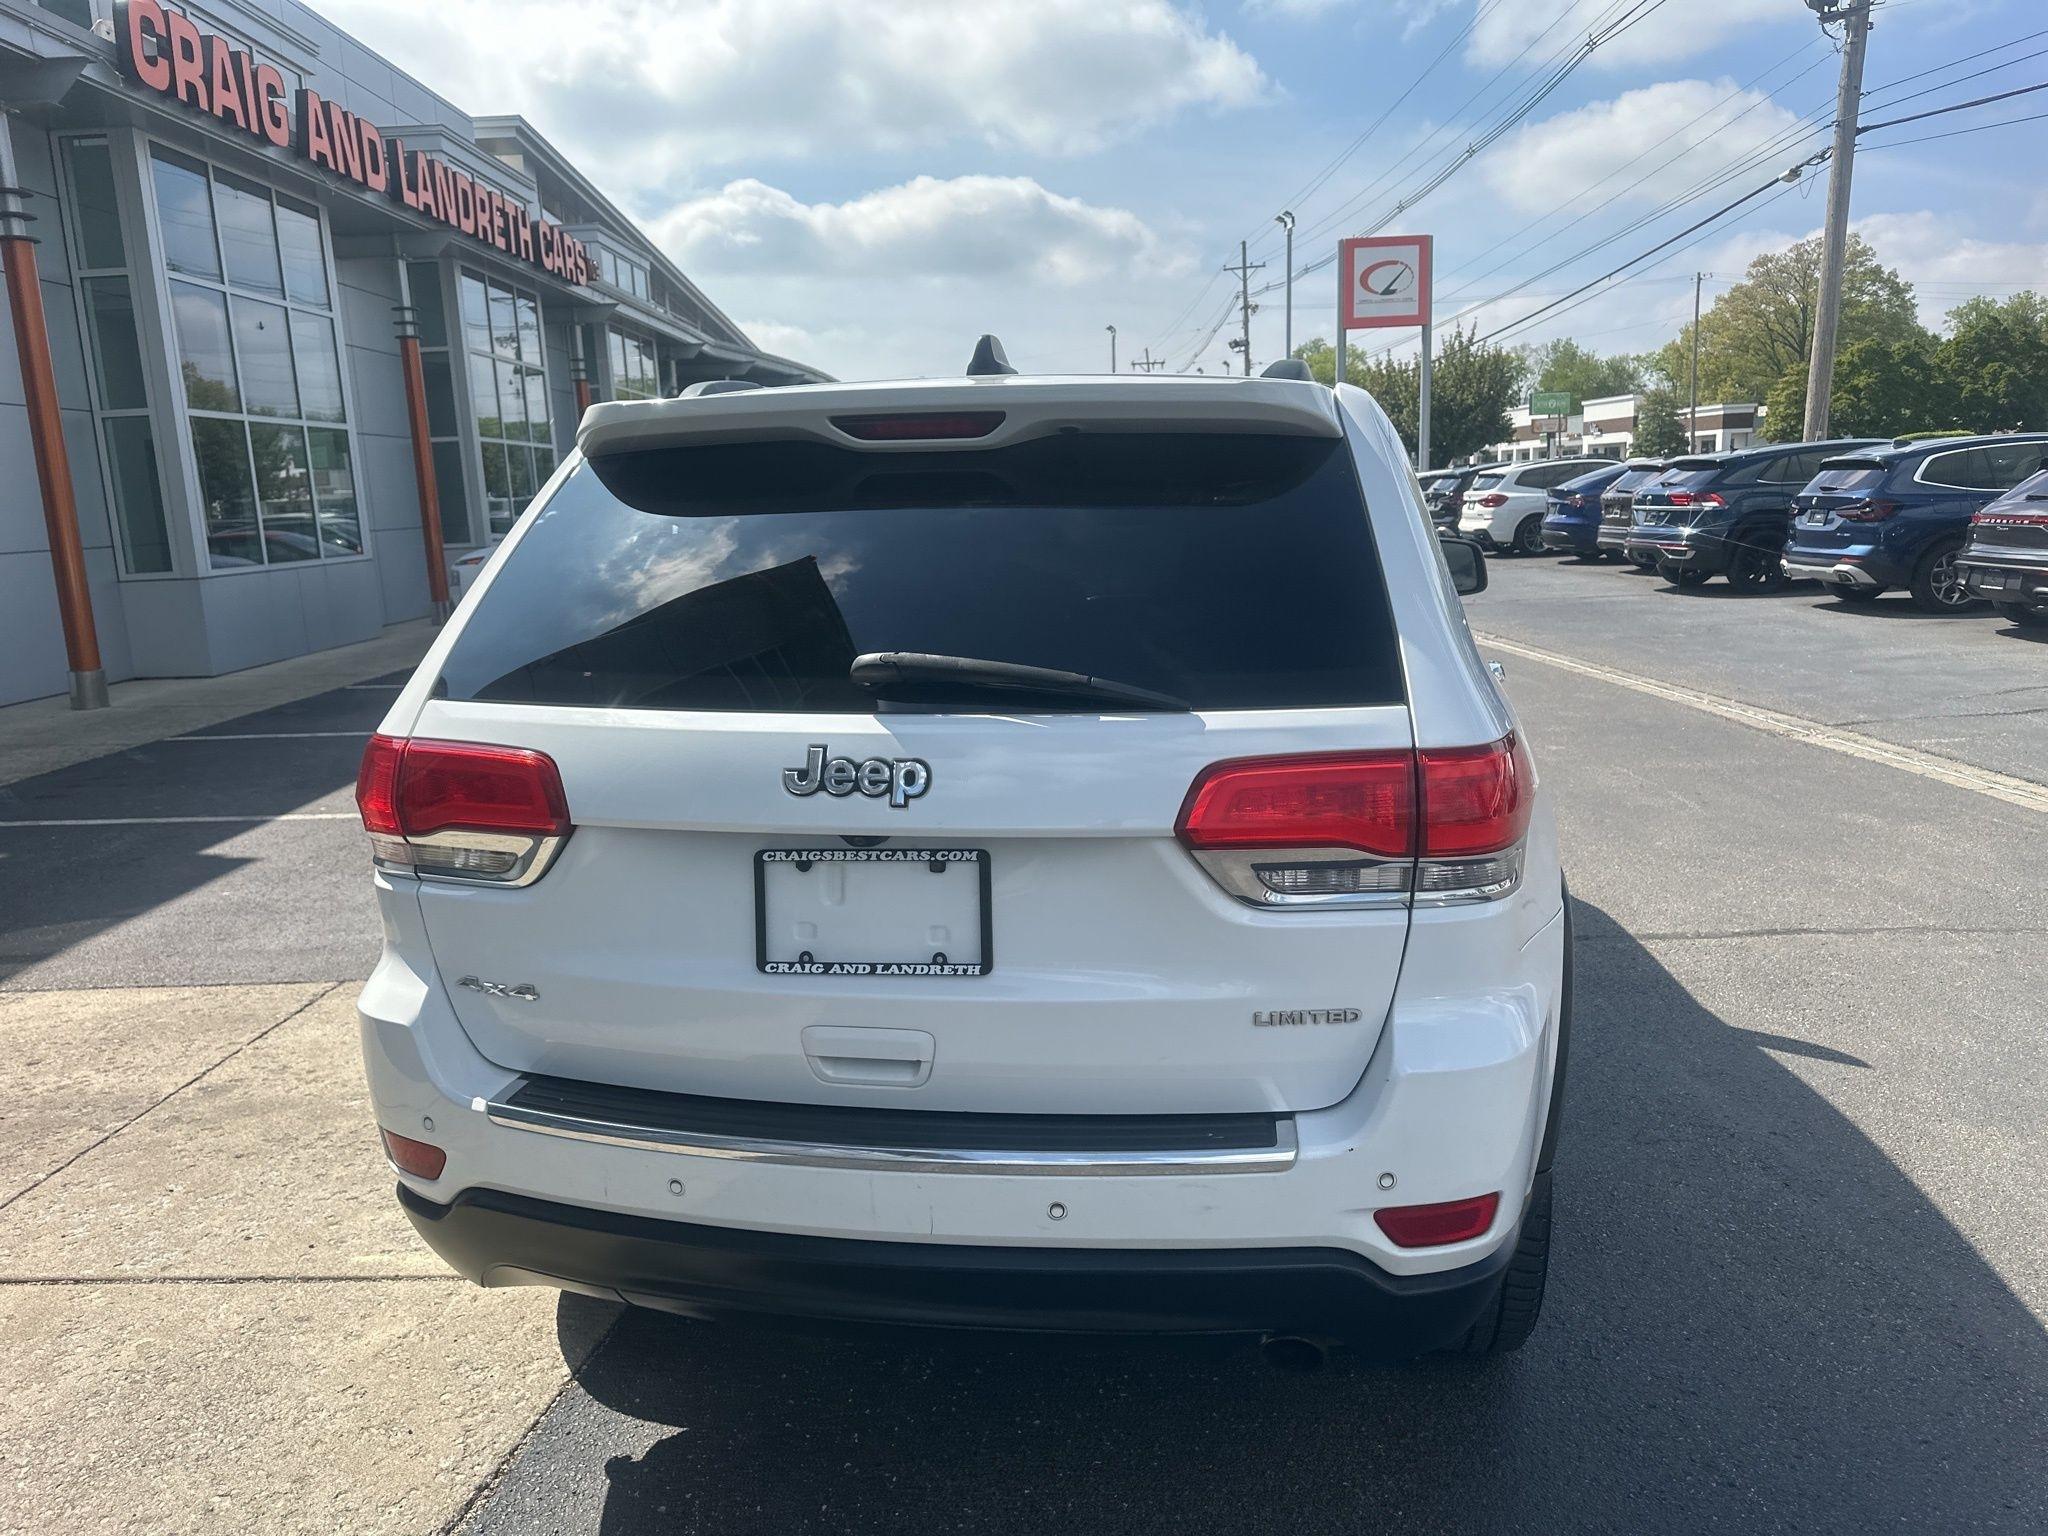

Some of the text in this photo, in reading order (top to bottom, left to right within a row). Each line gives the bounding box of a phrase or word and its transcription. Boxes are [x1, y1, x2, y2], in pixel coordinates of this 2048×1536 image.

[127, 0, 588, 287] CRAIG AND LANDRETH CARS
[783, 744, 932, 809] Jeep
[762, 850, 978, 862] CRAIGSBESTCARS.COM
[765, 963, 982, 976] CRAIG AND LANDRETH
[1253, 1007, 1362, 1027] LIMITED
